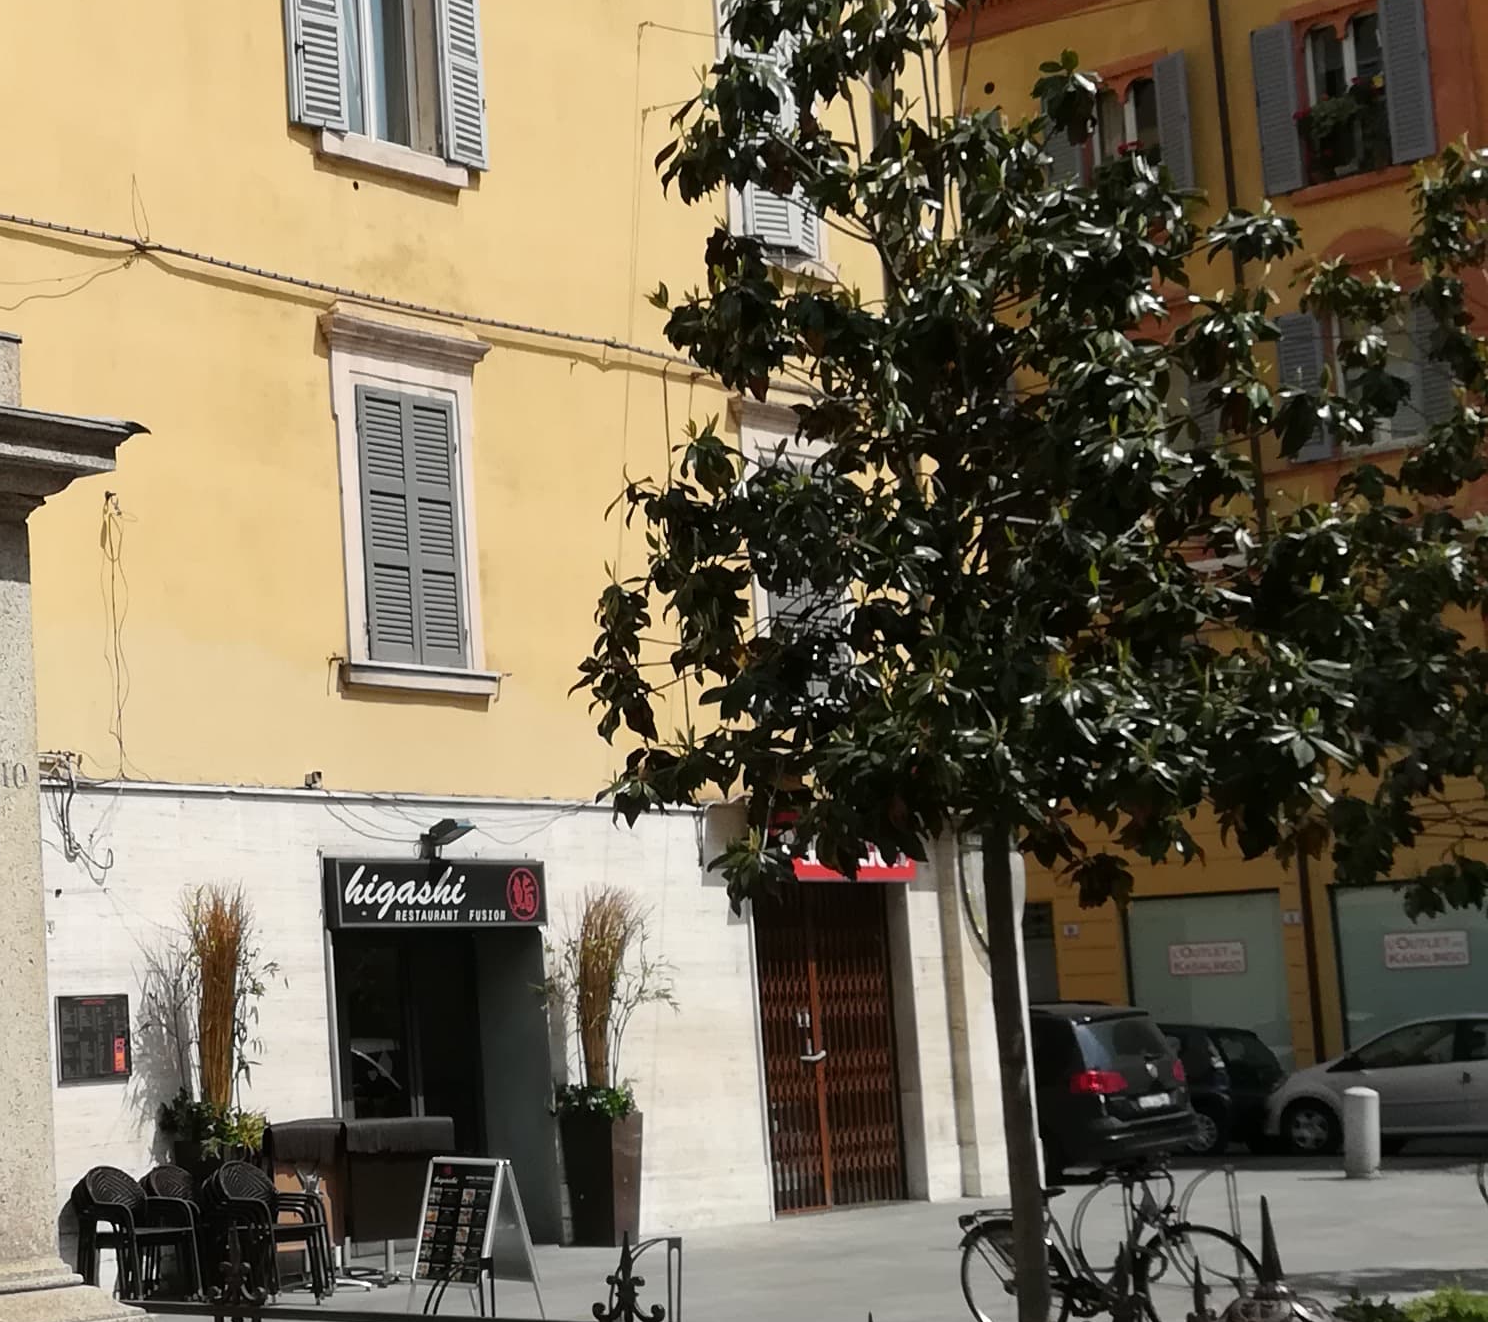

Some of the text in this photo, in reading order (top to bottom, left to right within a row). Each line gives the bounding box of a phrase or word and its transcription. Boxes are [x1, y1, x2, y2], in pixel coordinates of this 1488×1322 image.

[345, 865, 467, 919] higashi
[395, 909, 506, 921] RESTAURANT FUSION
